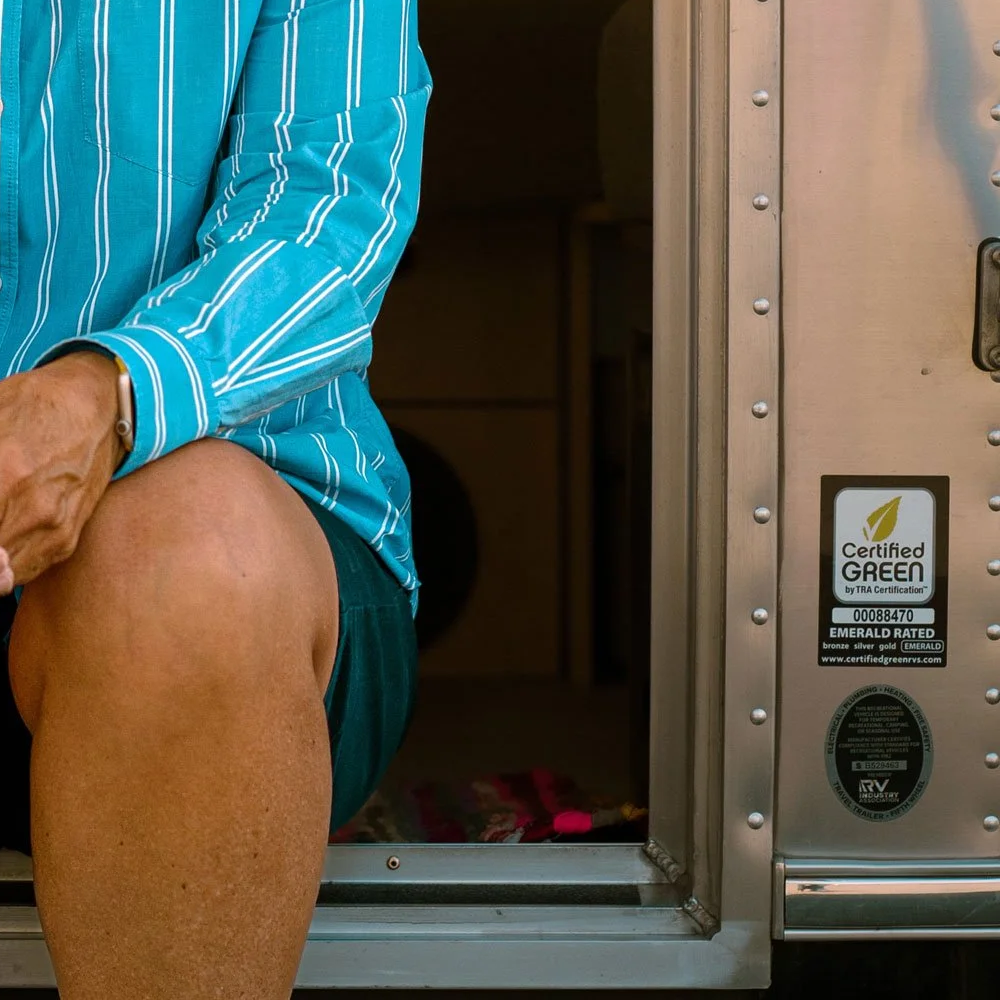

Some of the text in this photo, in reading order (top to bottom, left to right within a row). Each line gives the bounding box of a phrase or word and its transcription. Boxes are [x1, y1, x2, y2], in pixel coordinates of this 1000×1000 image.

[842, 542, 925, 559] Certified
[841, 561, 924, 582] GREEN
[845, 585, 855, 595] by
[856, 586, 872, 594] TRA
[853, 609, 914, 622] 00088470
[829, 628, 935, 639] EMERALD RATED
[822, 642, 850, 650] bronze
[854, 642, 874, 650] silver
[879, 642, 896, 651] gold
[821, 655, 942, 665] www.certifiedgreenrvs.com
[827, 713, 843, 754] ELECTRICAL
[843, 687, 878, 709] PLUMBING
[884, 687, 913, 706] HEATING
[833, 780, 851, 808] TRAVEL
[852, 805, 884, 819] TRAILER
